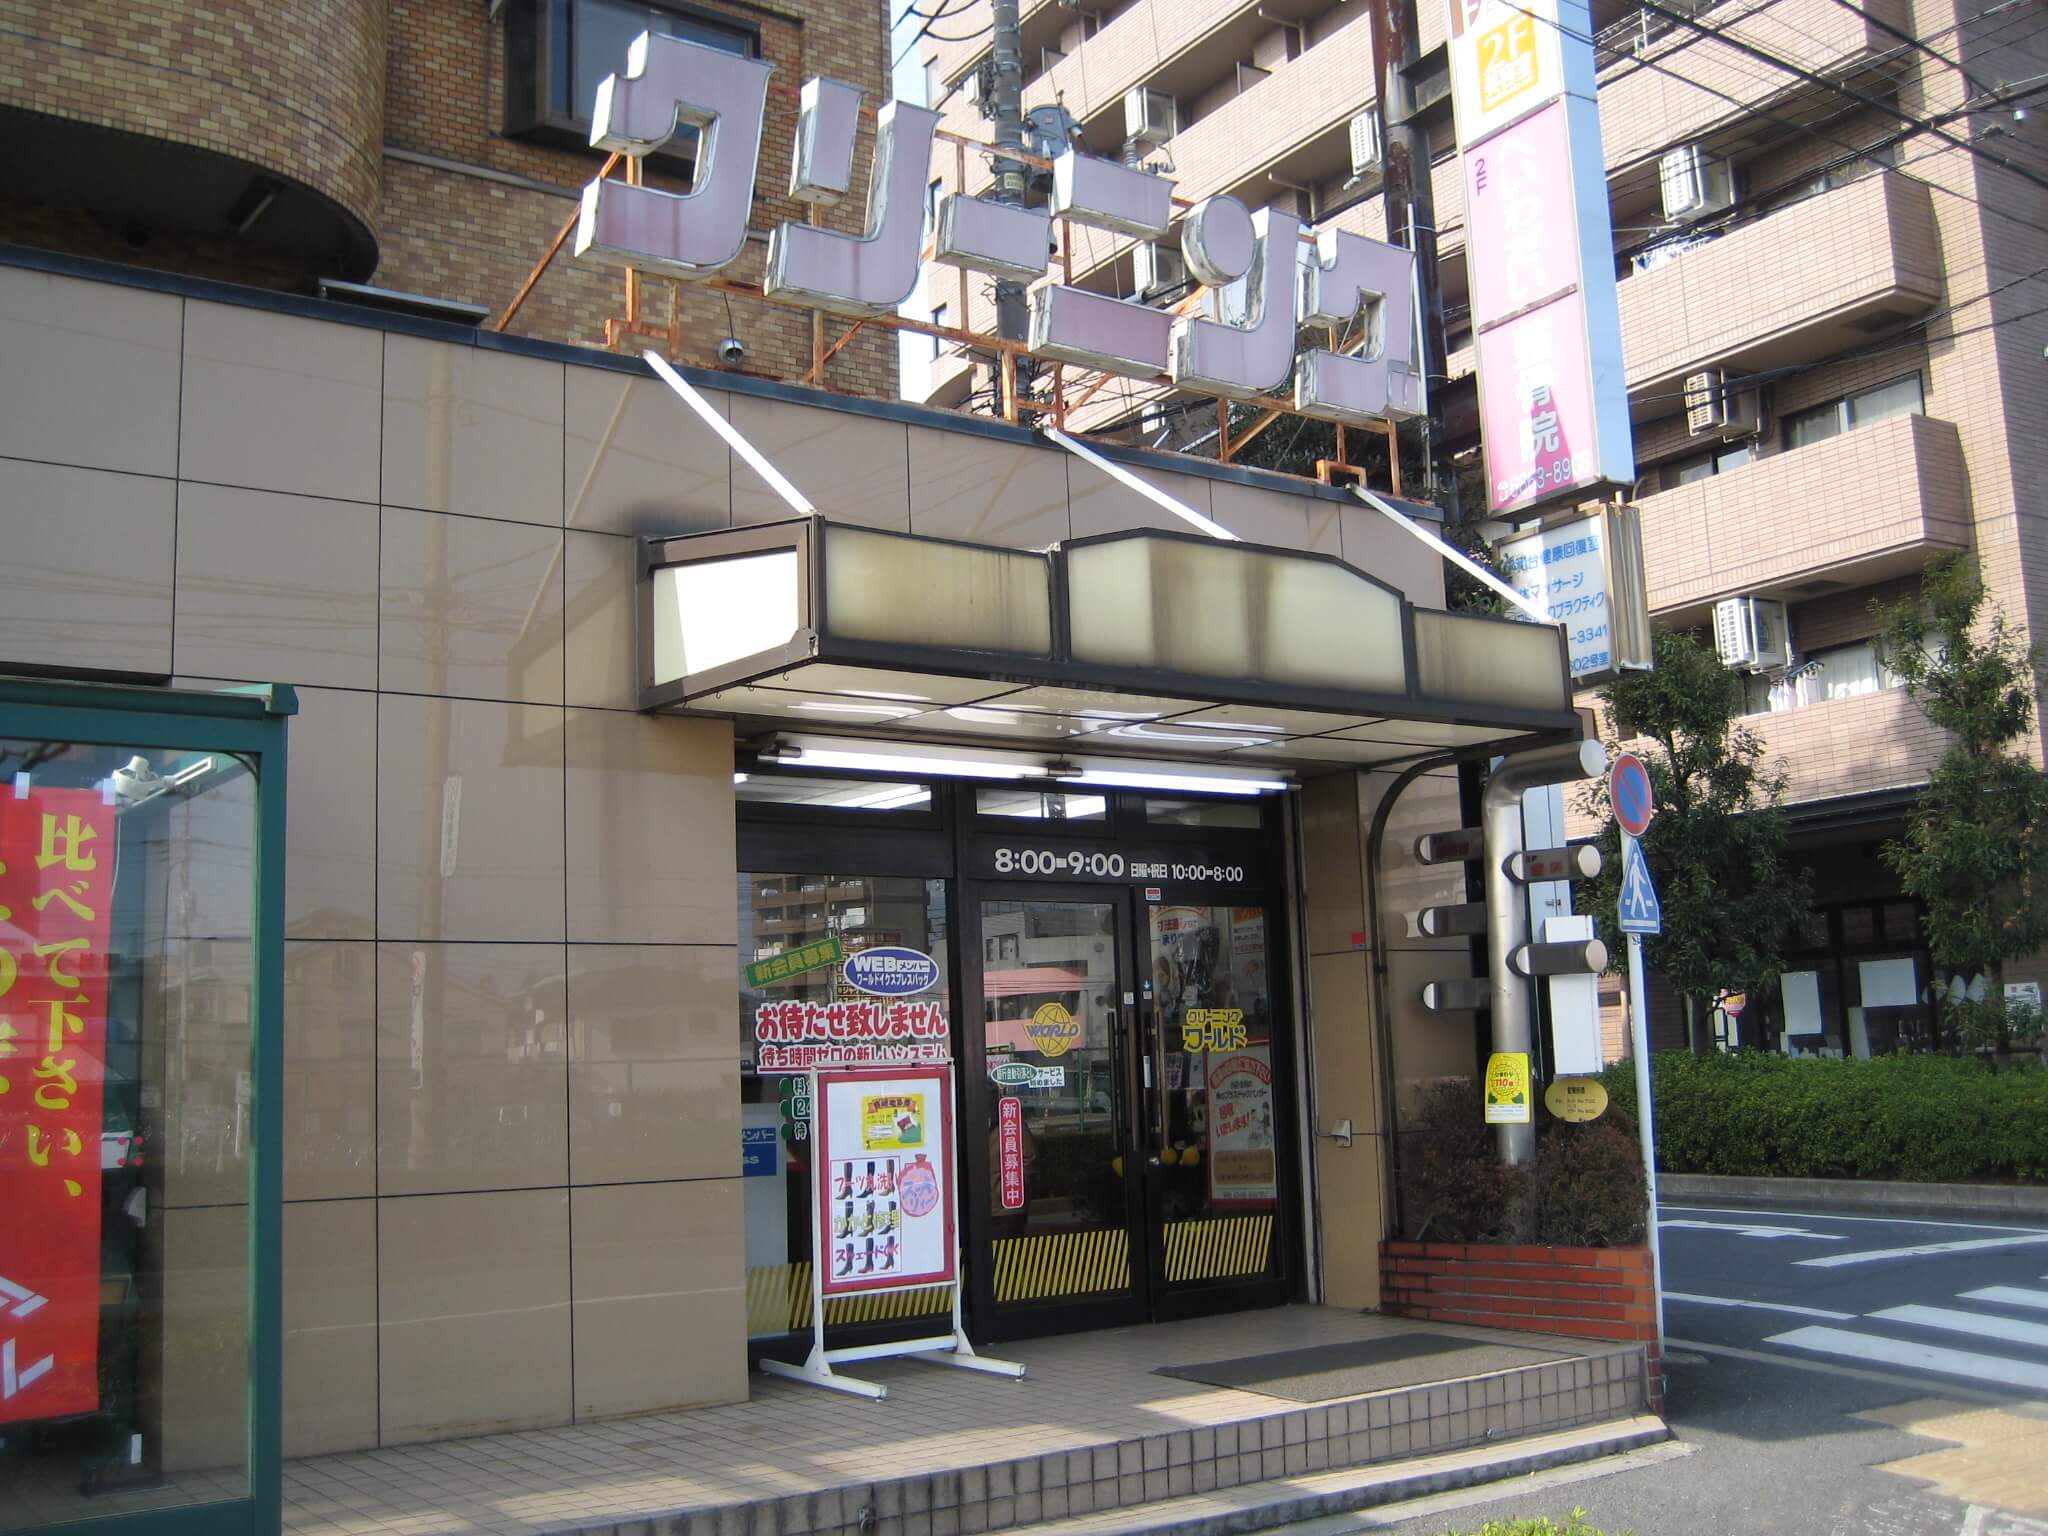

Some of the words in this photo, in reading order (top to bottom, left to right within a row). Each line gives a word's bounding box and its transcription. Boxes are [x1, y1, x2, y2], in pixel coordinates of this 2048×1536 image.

[1475, 158, 1487, 196] 2F
[757, 1001, 948, 1041] お待たせ致しません
[1026, 1023, 1080, 1037] WORLD
[1184, 1026, 1247, 1050] ワールド
[1002, 1102, 1020, 1205] 新会員募集中
